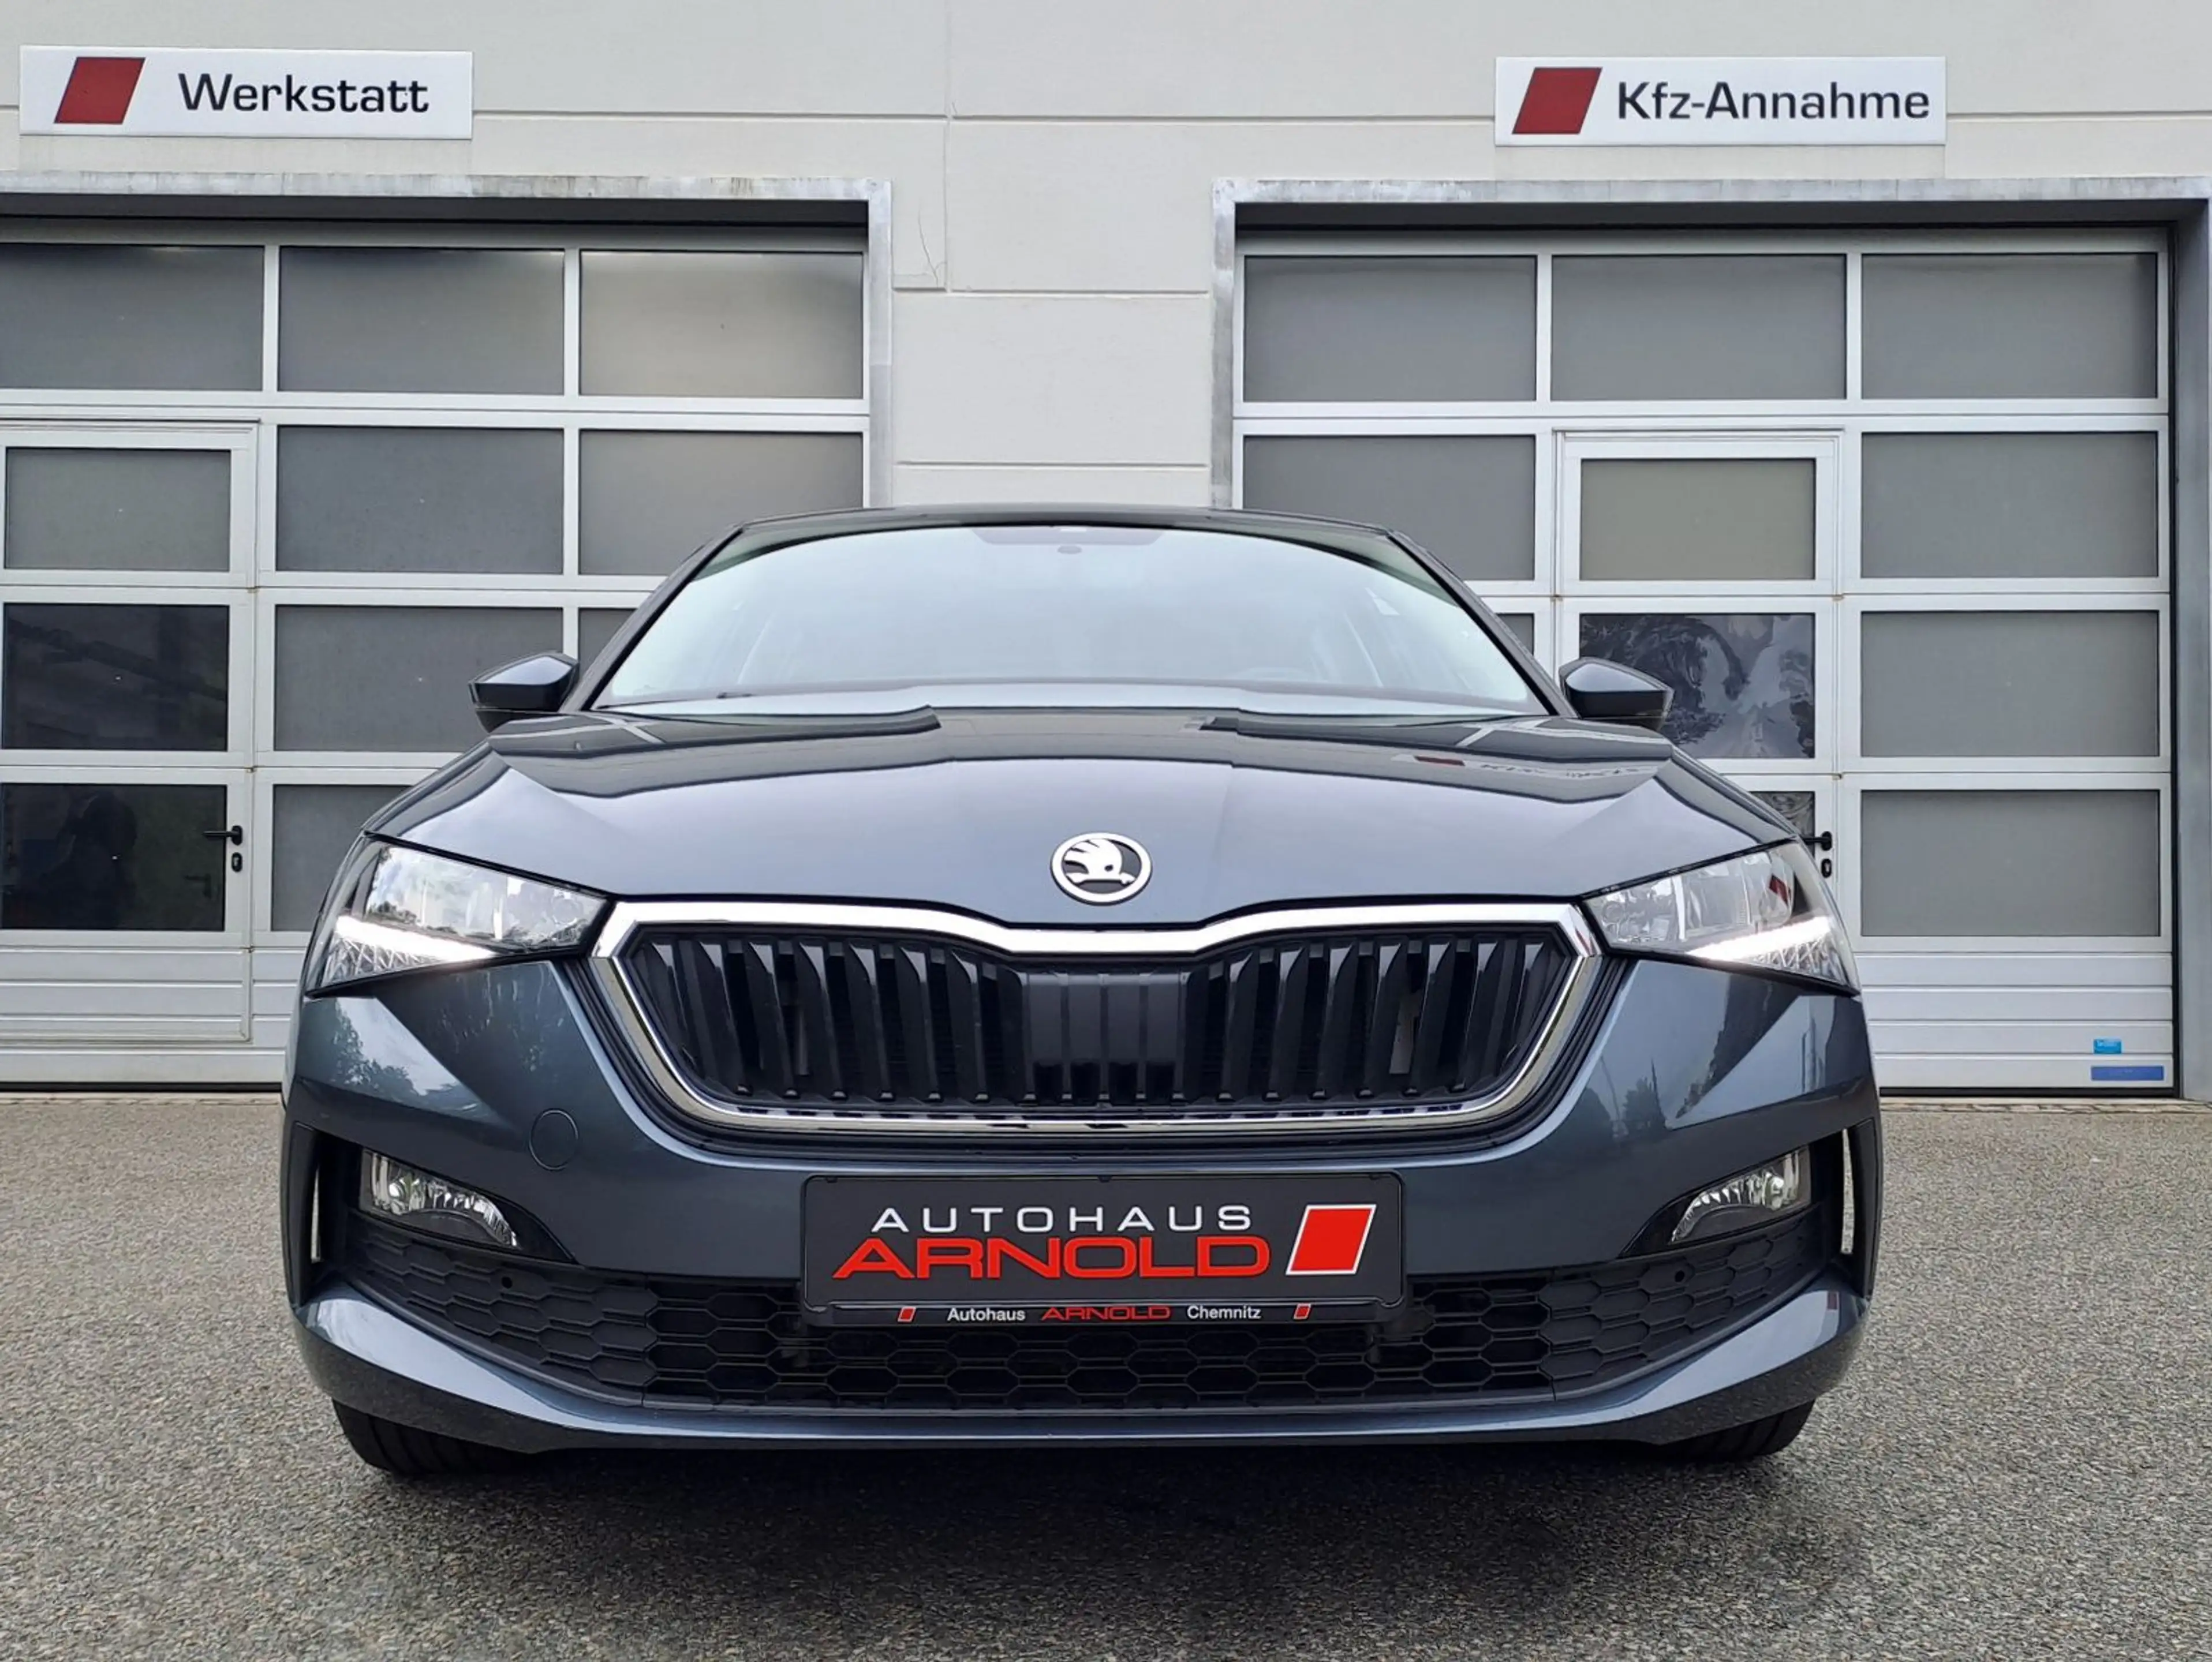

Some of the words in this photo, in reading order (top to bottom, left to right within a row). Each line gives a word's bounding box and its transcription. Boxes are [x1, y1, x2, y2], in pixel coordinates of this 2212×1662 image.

[178, 73, 429, 113] Werkstatt
[1619, 81, 1929, 119] Kfz-Annahme
[870, 1204, 1252, 1233] AUTOHAUS
[832, 1236, 1270, 1280] ARNOLD
[947, 1305, 1026, 1322] Autohaus
[1041, 1305, 1171, 1320] ARNOLD
[1186, 1304, 1262, 1320] Chemnitz
